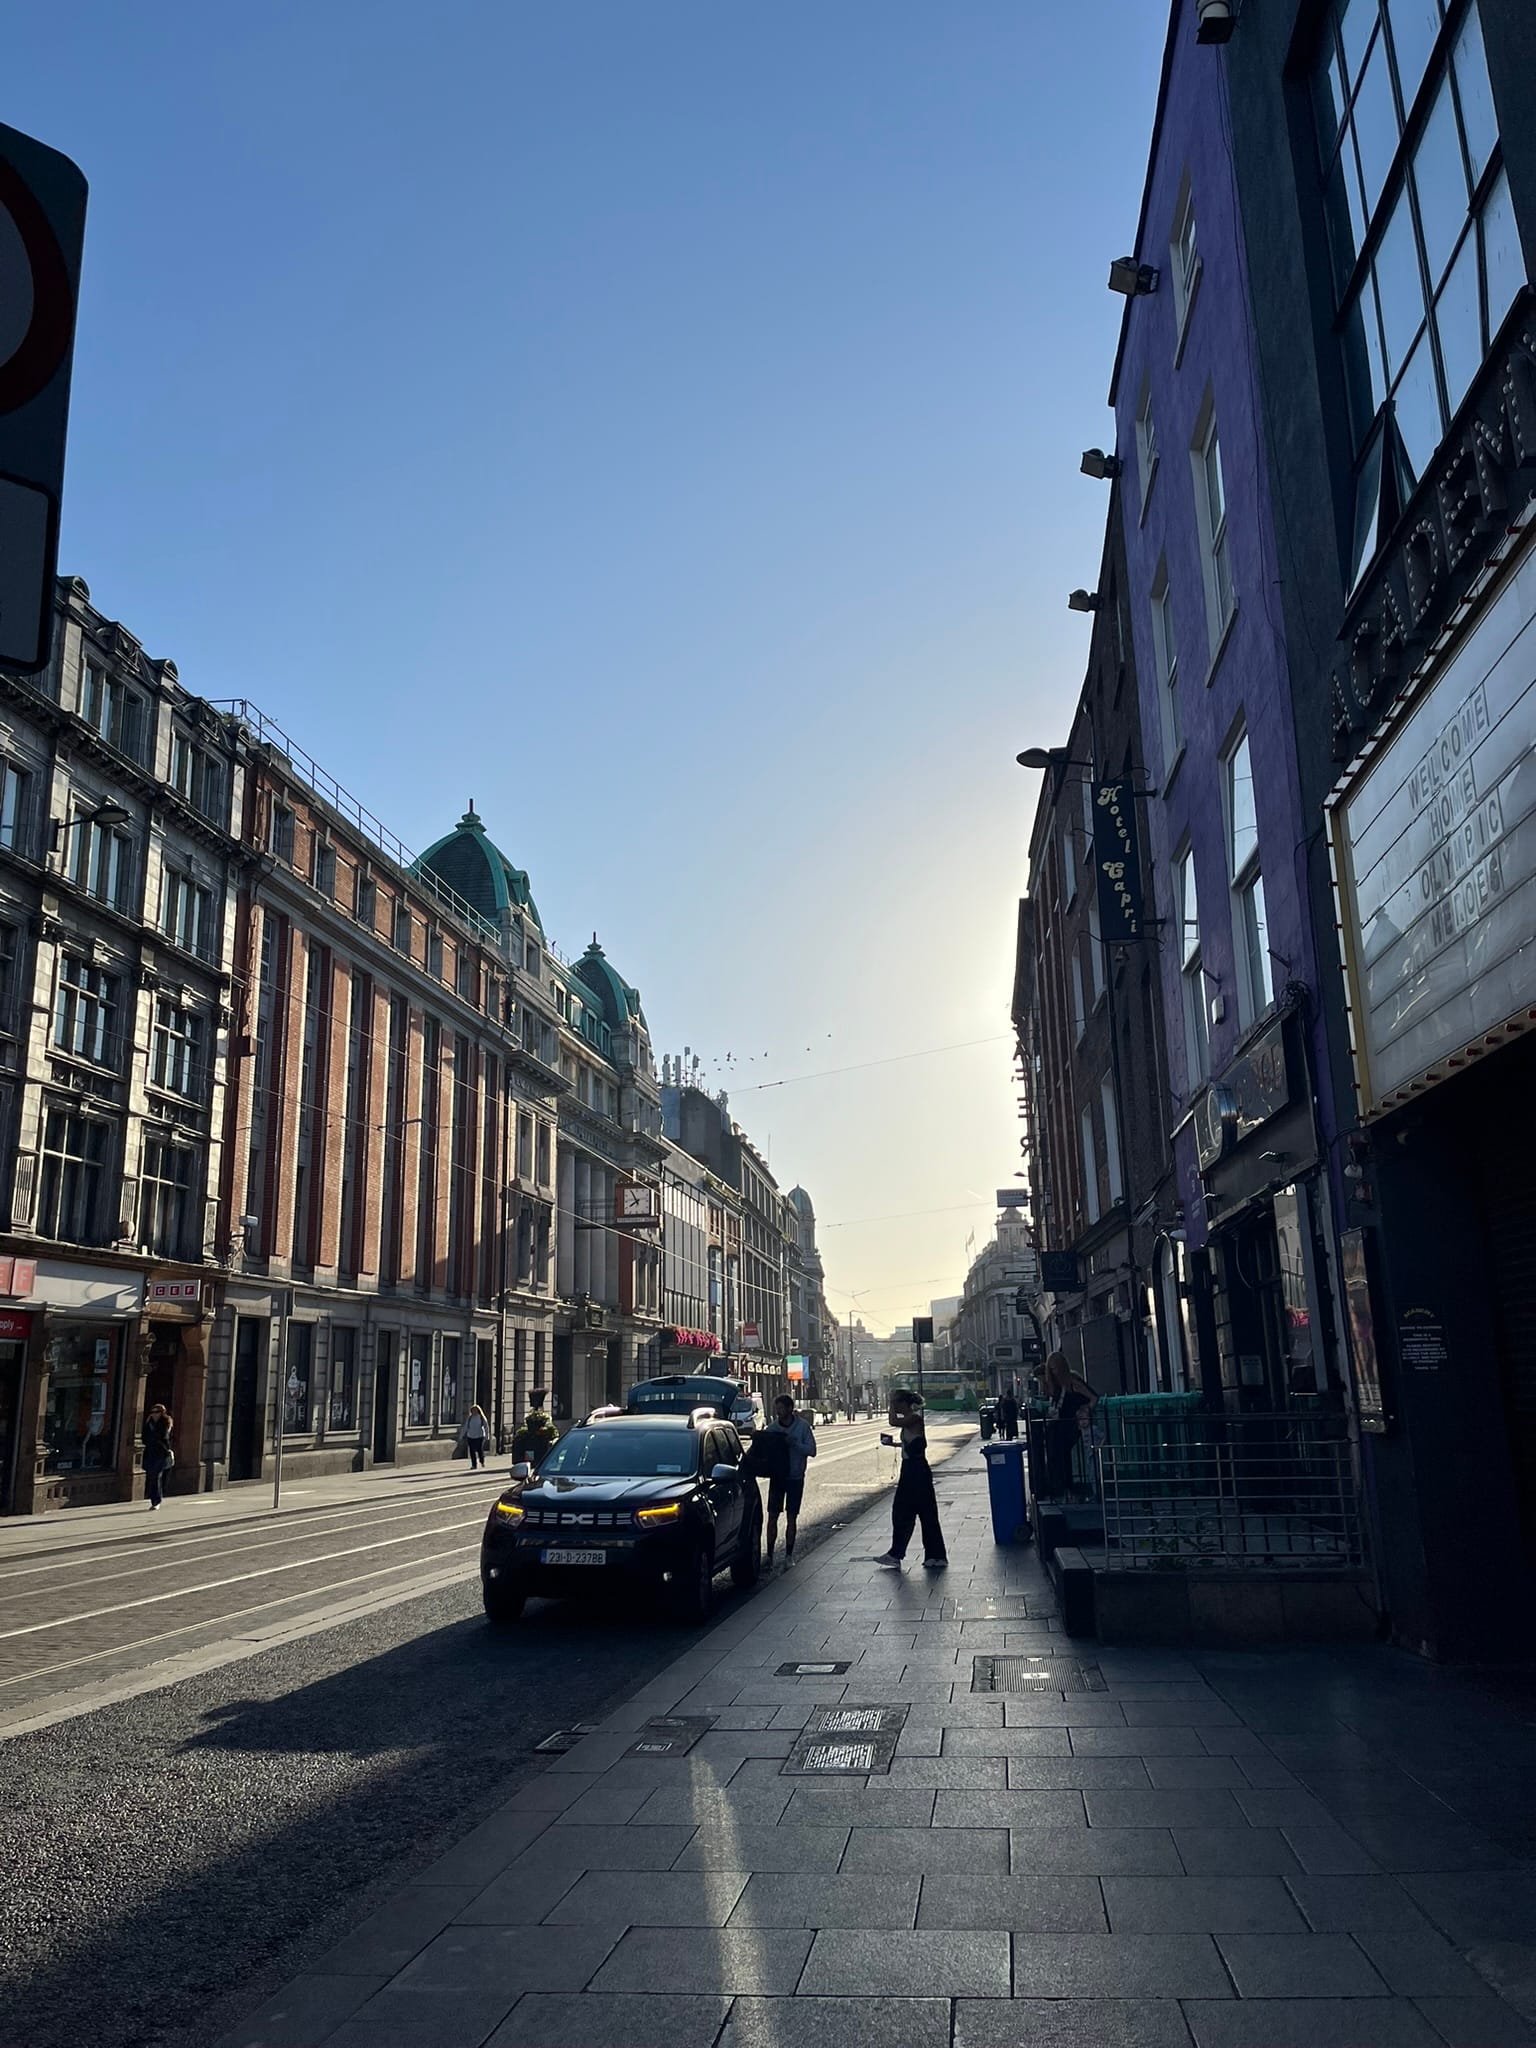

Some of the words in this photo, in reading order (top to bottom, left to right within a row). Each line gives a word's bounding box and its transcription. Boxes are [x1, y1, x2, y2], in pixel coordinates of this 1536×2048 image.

[1327, 328, 1536, 762] ACADEM
[1407, 694, 1486, 809] WELCOME
[1096, 784, 1132, 854] Hotel
[1429, 767, 1473, 841] HOME
[1421, 799, 1499, 900] OLYMPIC
[1102, 861, 1137, 933] Capri
[156, 1286, 194, 1296] CEF
[549, 1551, 603, 1564] 231-D-23788
